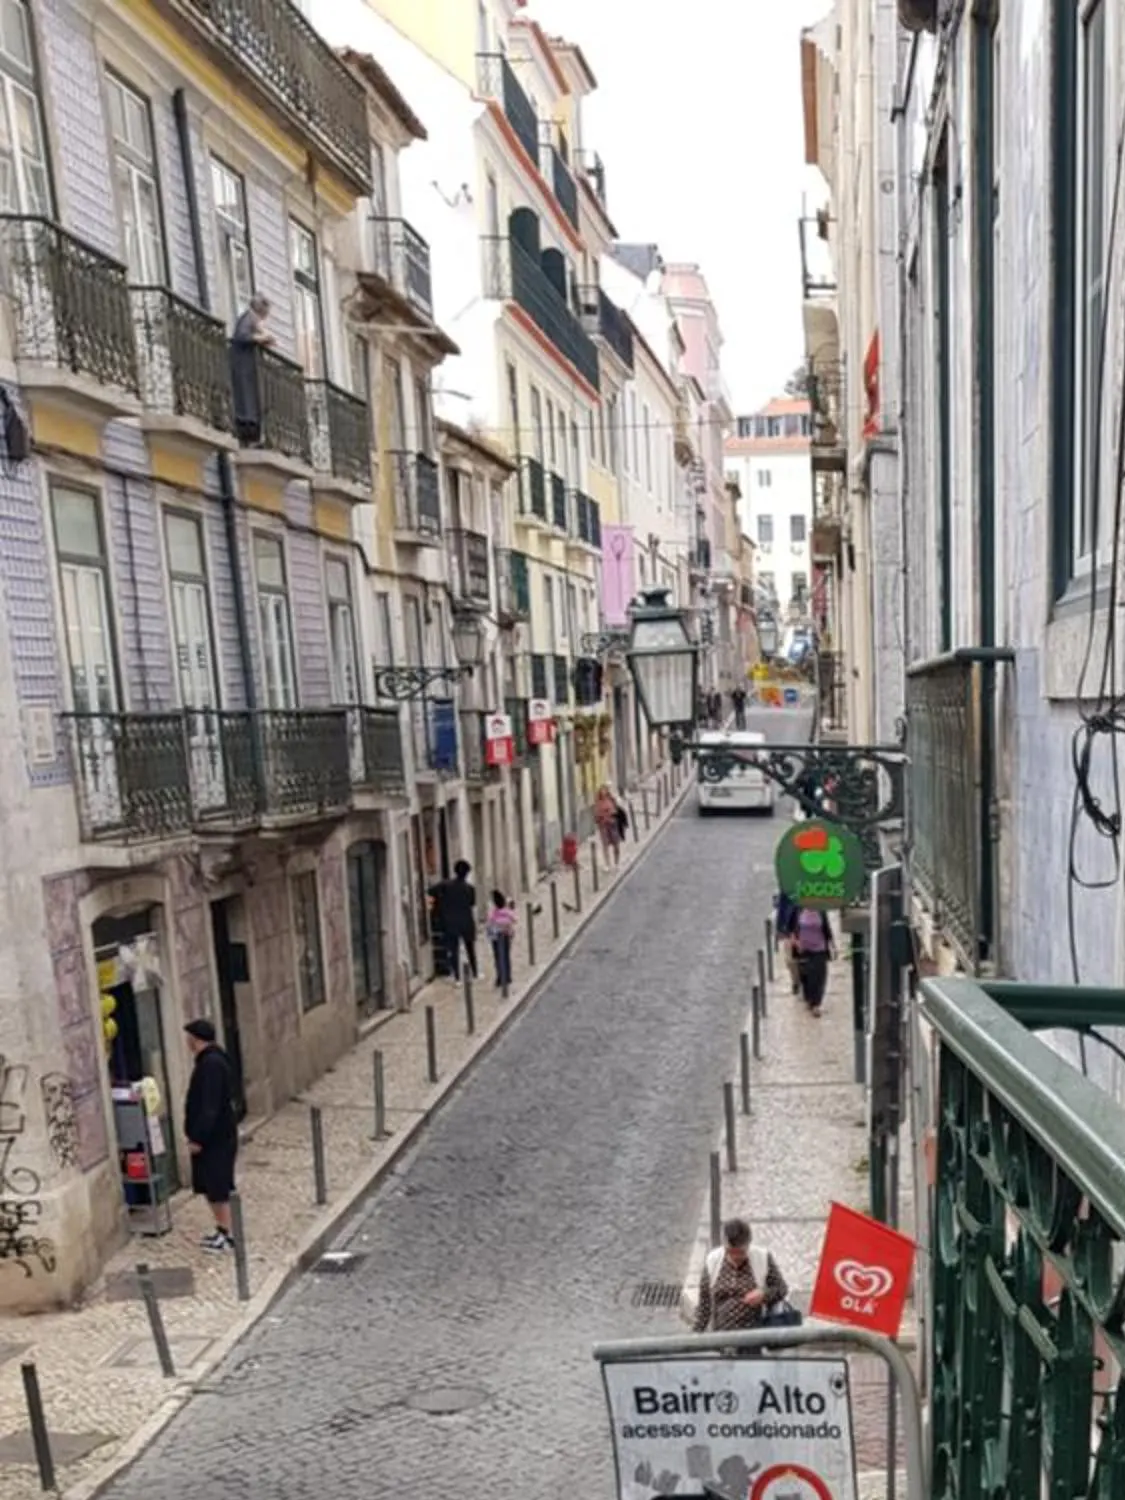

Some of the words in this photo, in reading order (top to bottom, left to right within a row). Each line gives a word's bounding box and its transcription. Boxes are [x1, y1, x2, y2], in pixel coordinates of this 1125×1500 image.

[633, 1384, 739, 1415] Bairr
[757, 1382, 826, 1415] Alto
[622, 1422, 697, 1439] acesso
[707, 1420, 842, 1439] condicionado
